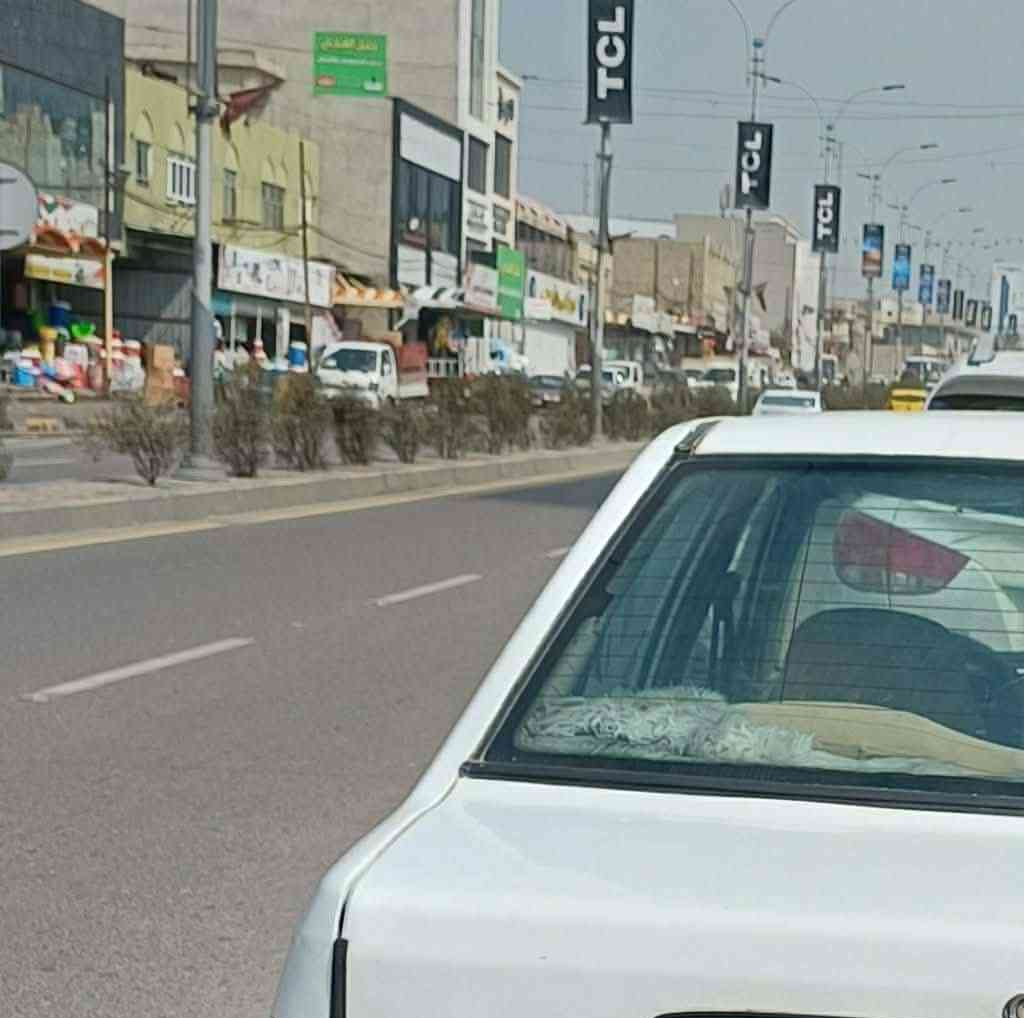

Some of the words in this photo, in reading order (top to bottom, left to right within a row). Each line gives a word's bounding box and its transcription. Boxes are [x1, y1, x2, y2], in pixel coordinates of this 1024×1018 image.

[596, 5, 626, 100] TCL
[741, 131, 762, 194] TCL
[816, 192, 833, 240] TCL
